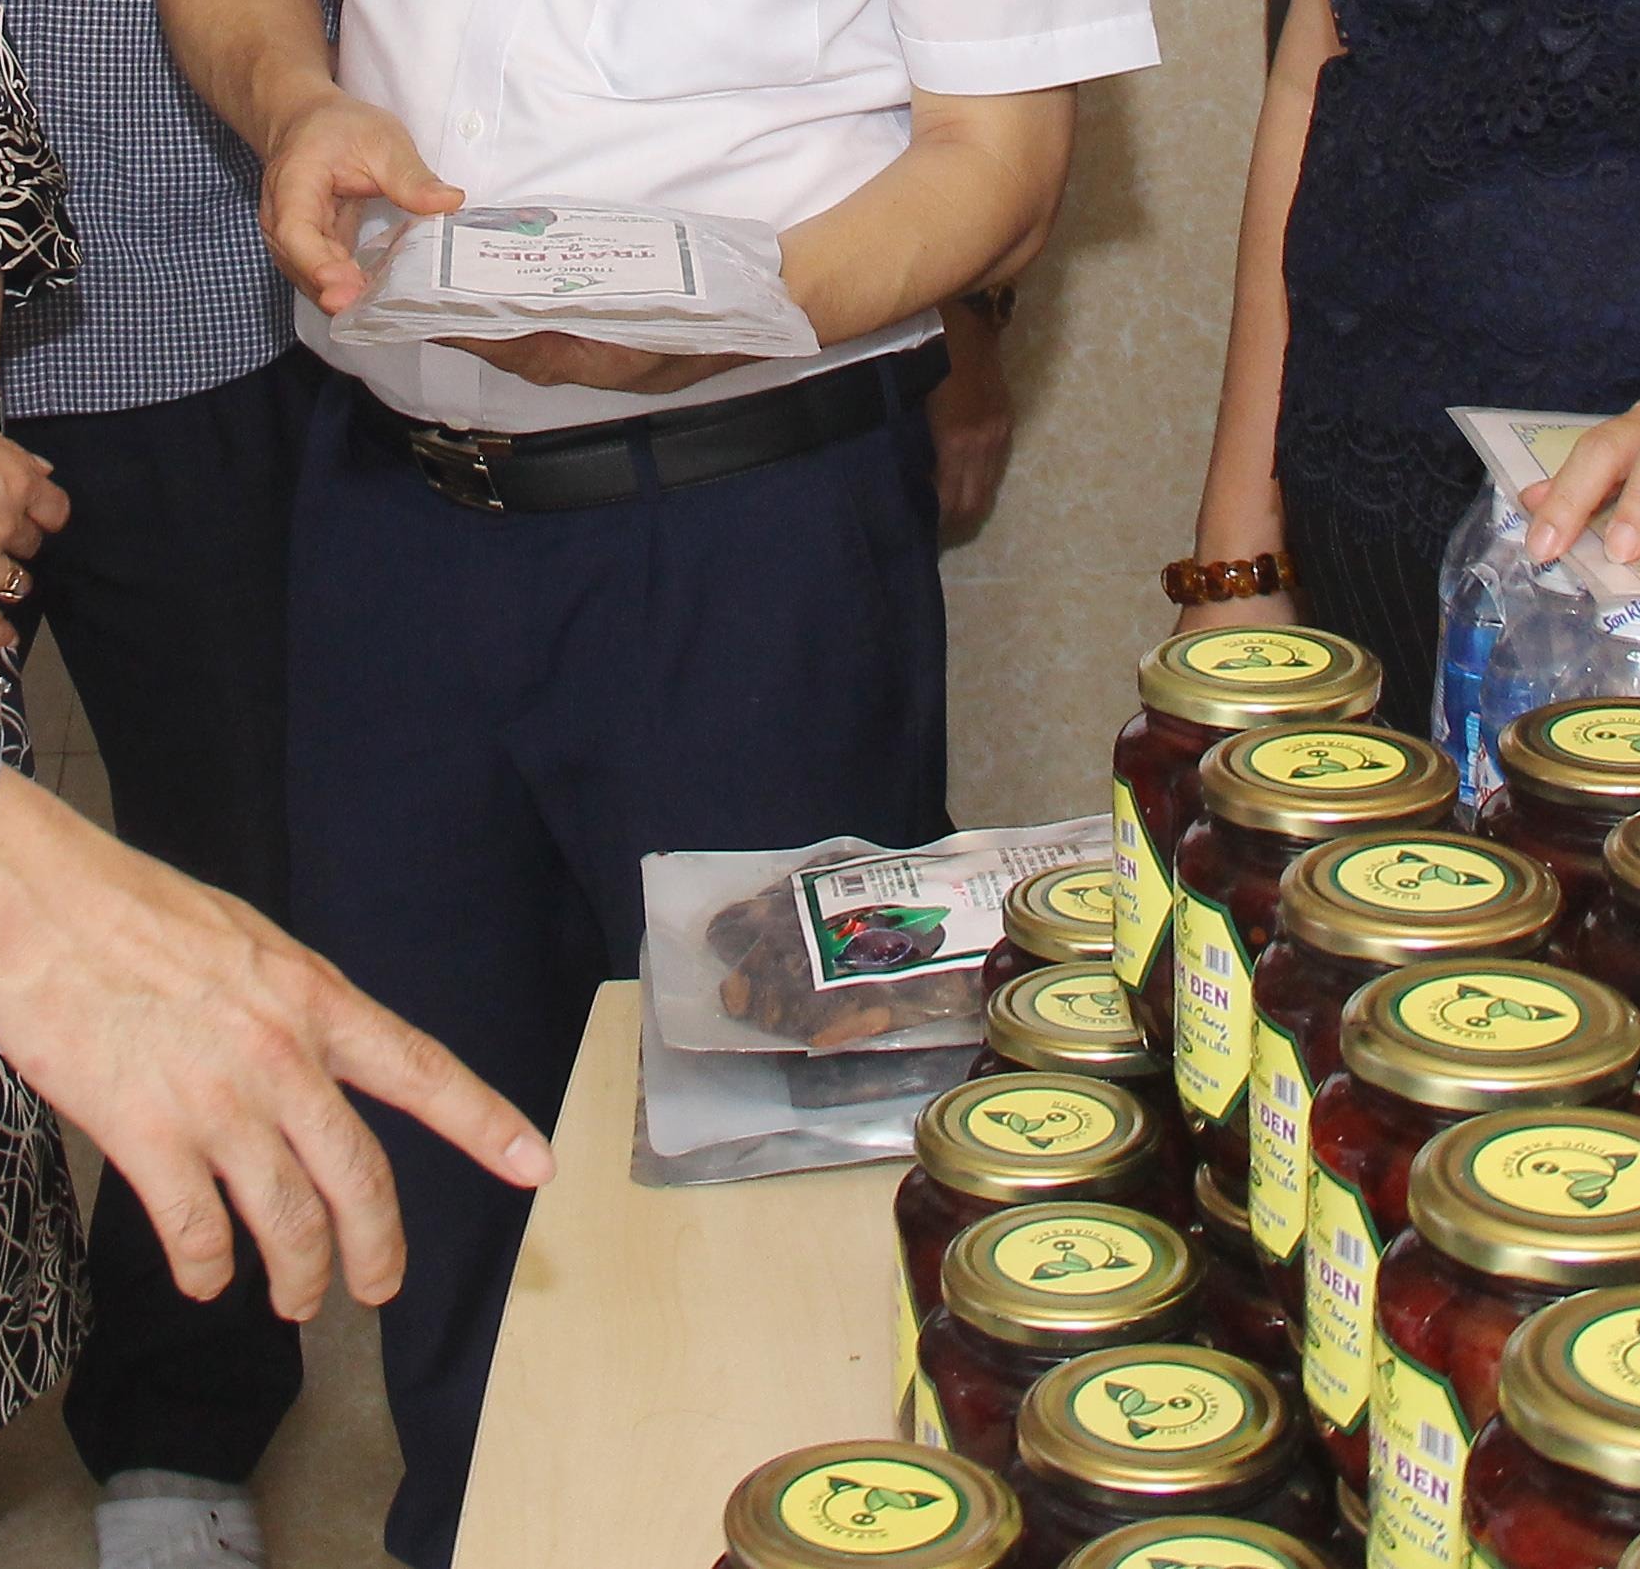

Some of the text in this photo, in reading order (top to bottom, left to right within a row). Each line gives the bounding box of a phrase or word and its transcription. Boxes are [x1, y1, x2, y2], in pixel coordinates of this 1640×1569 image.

[1190, 972, 1229, 1011] ĐEN
[1260, 1102, 1297, 1145] ĐEN
[1320, 1258, 1361, 1308] ĐEN
[1395, 1452, 1450, 1507] ĐEN
